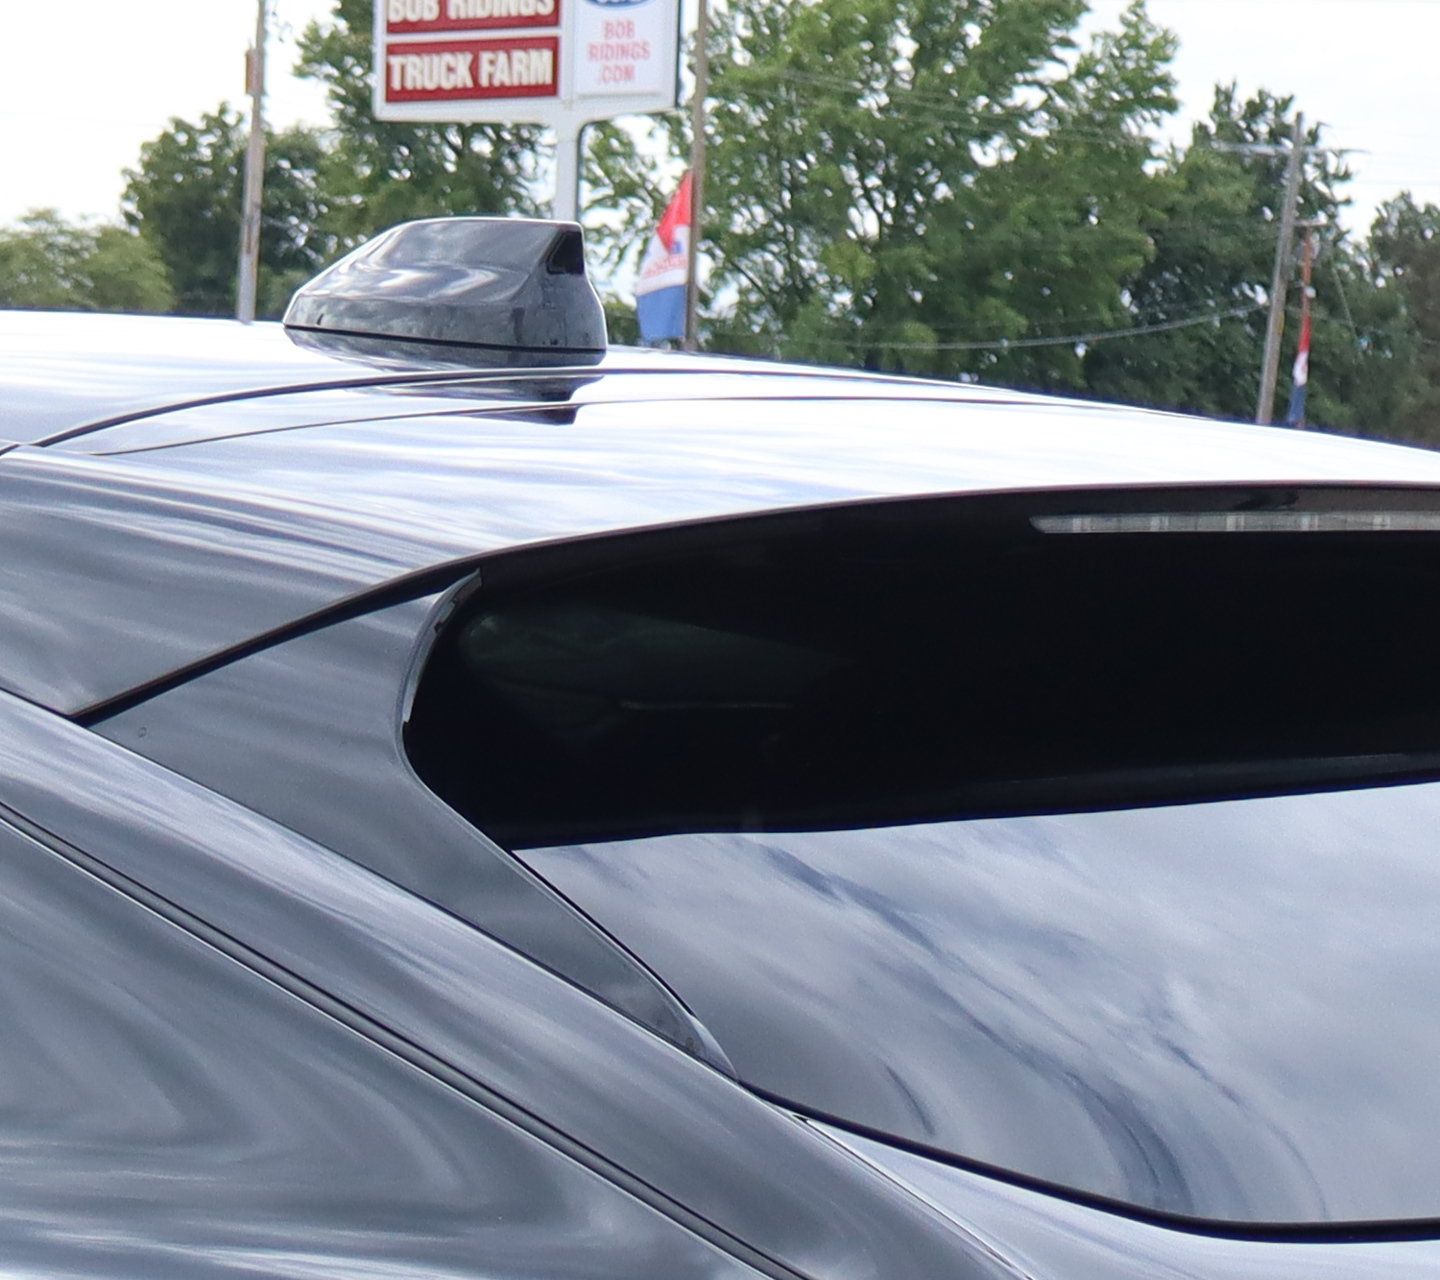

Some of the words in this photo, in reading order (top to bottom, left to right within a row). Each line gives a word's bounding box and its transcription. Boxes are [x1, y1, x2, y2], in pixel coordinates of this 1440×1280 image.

[604, 20, 635, 39] BOB
[587, 42, 650, 61] RIDINGS
[388, 51, 474, 91] TRUCK
[479, 48, 553, 87] FARM
